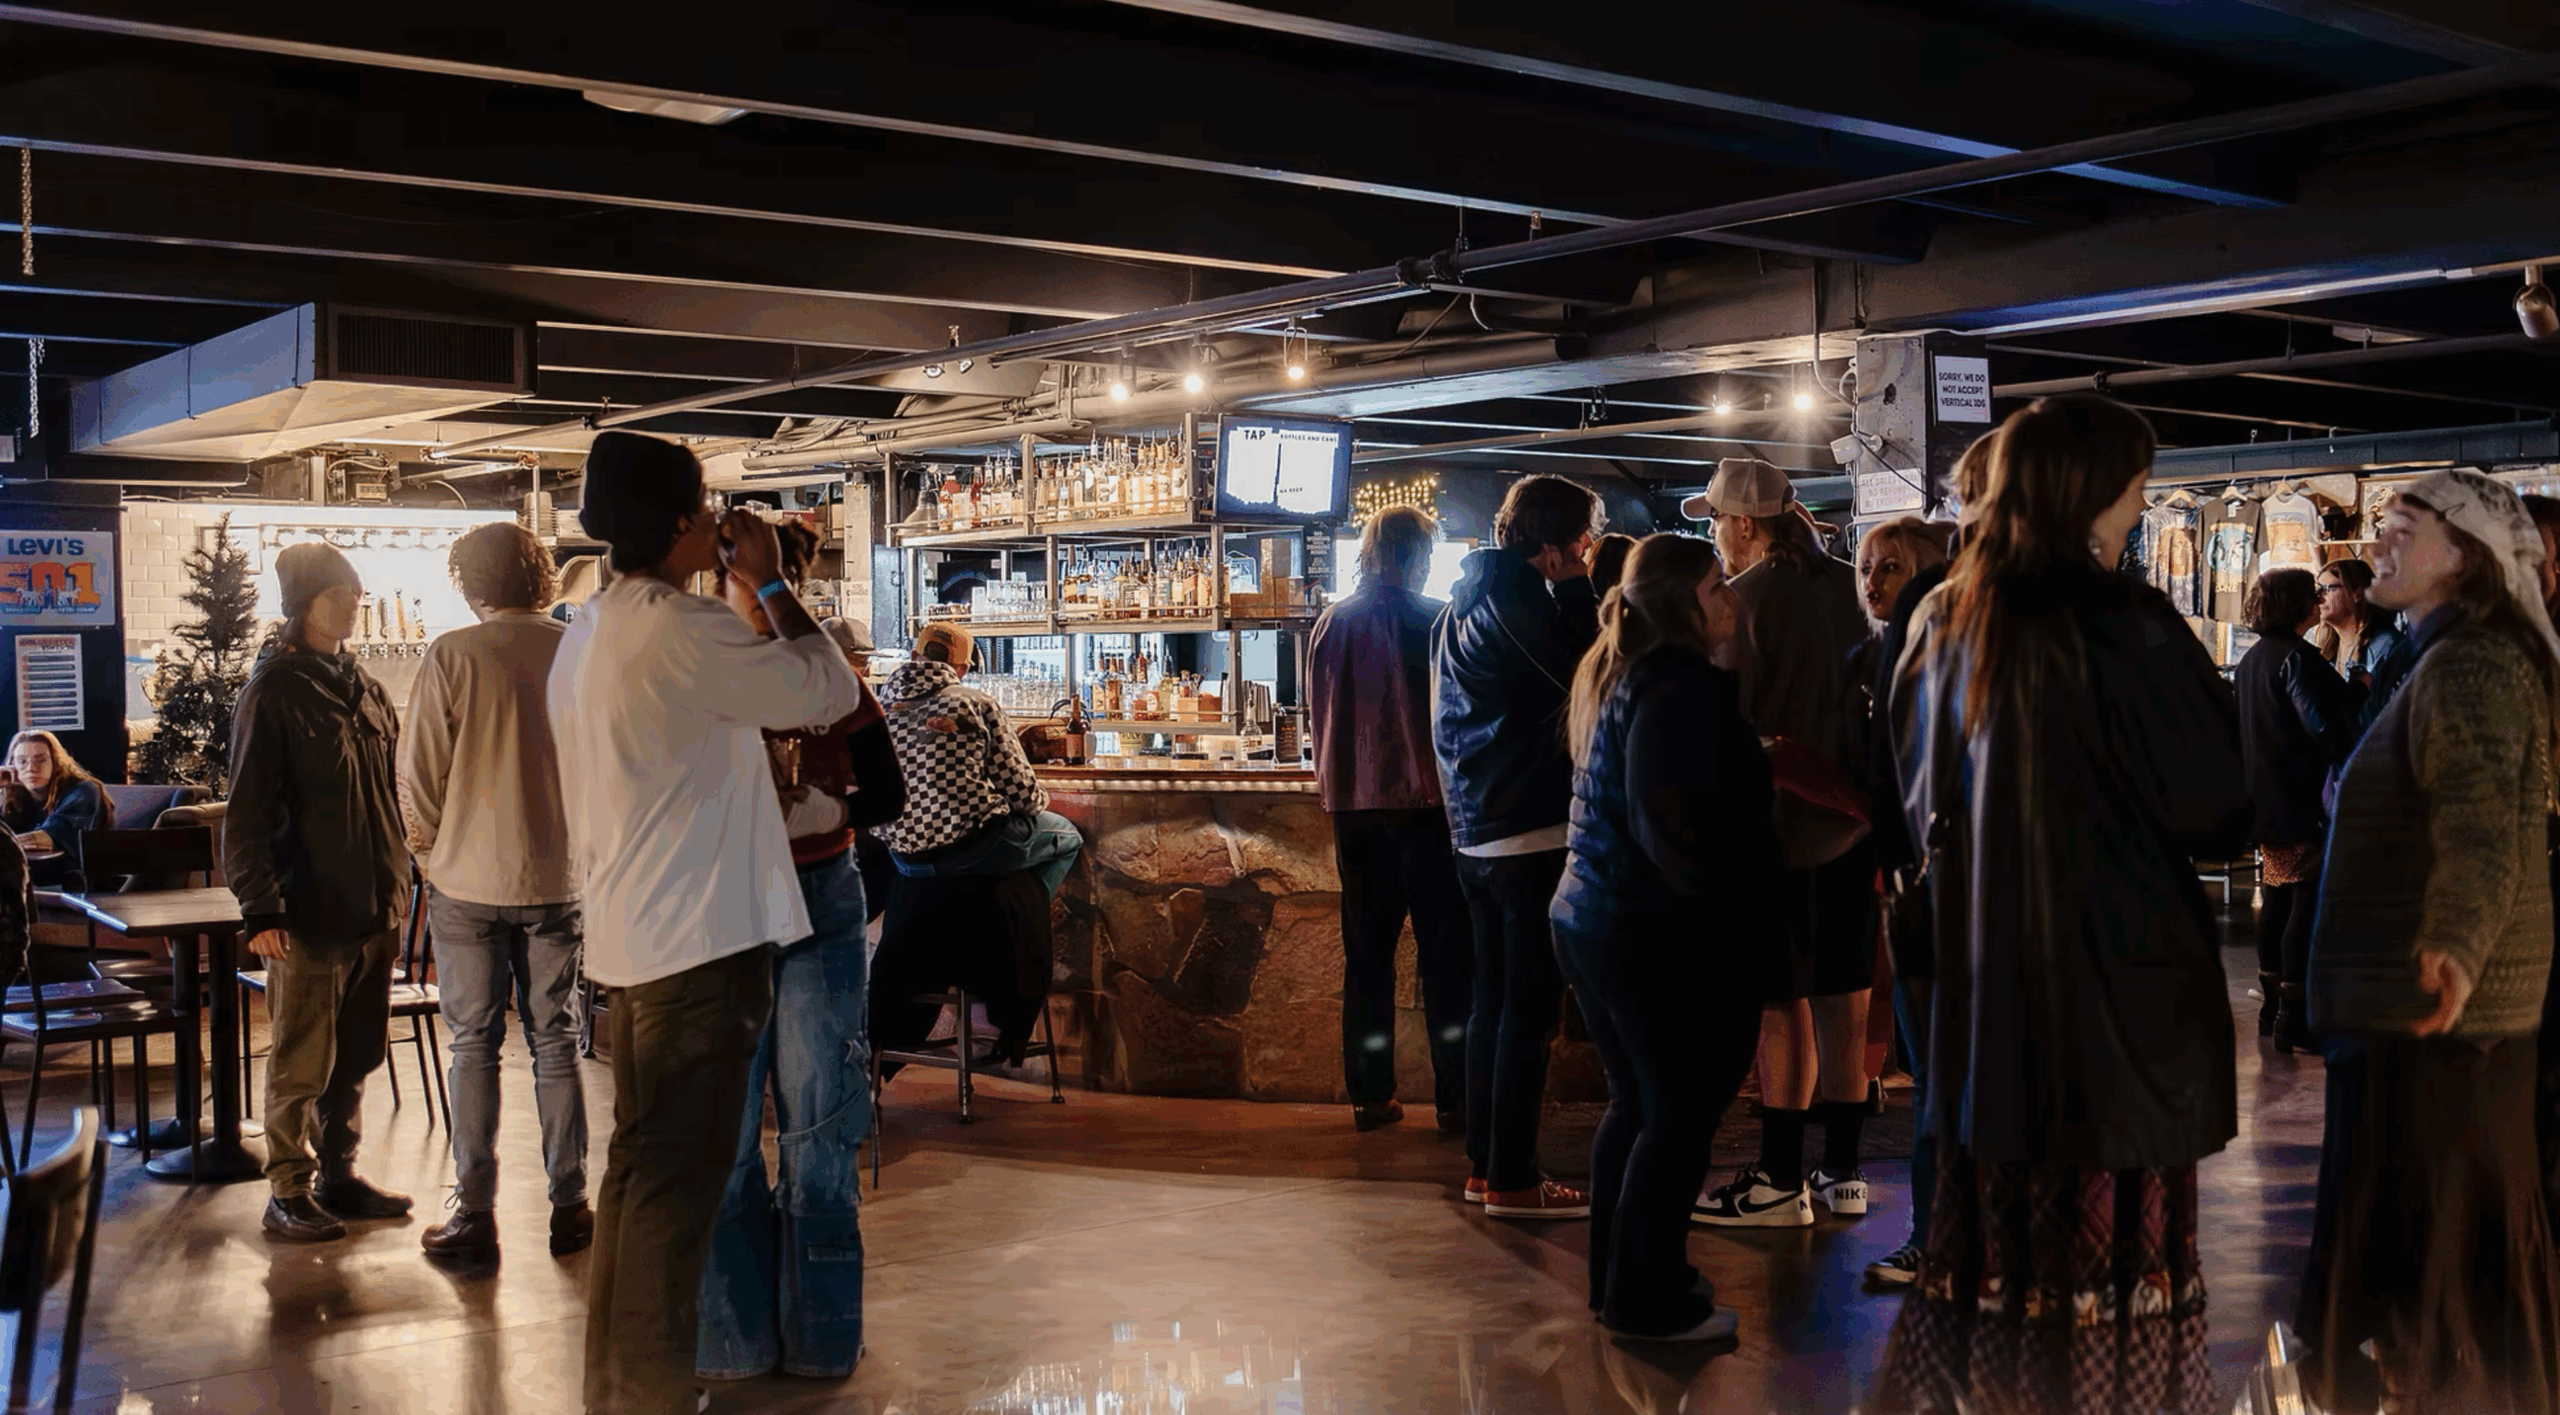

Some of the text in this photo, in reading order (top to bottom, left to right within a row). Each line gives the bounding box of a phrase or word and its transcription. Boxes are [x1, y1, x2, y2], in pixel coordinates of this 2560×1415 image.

[1939, 372, 1986, 383] SORRY, WE DO
[1942, 385, 1983, 395] NOT ACCEPT
[1940, 398, 1972, 407] VERTICAL
[1244, 430, 1266, 440] TAP
[1834, 1187, 1867, 1200] NIKE
